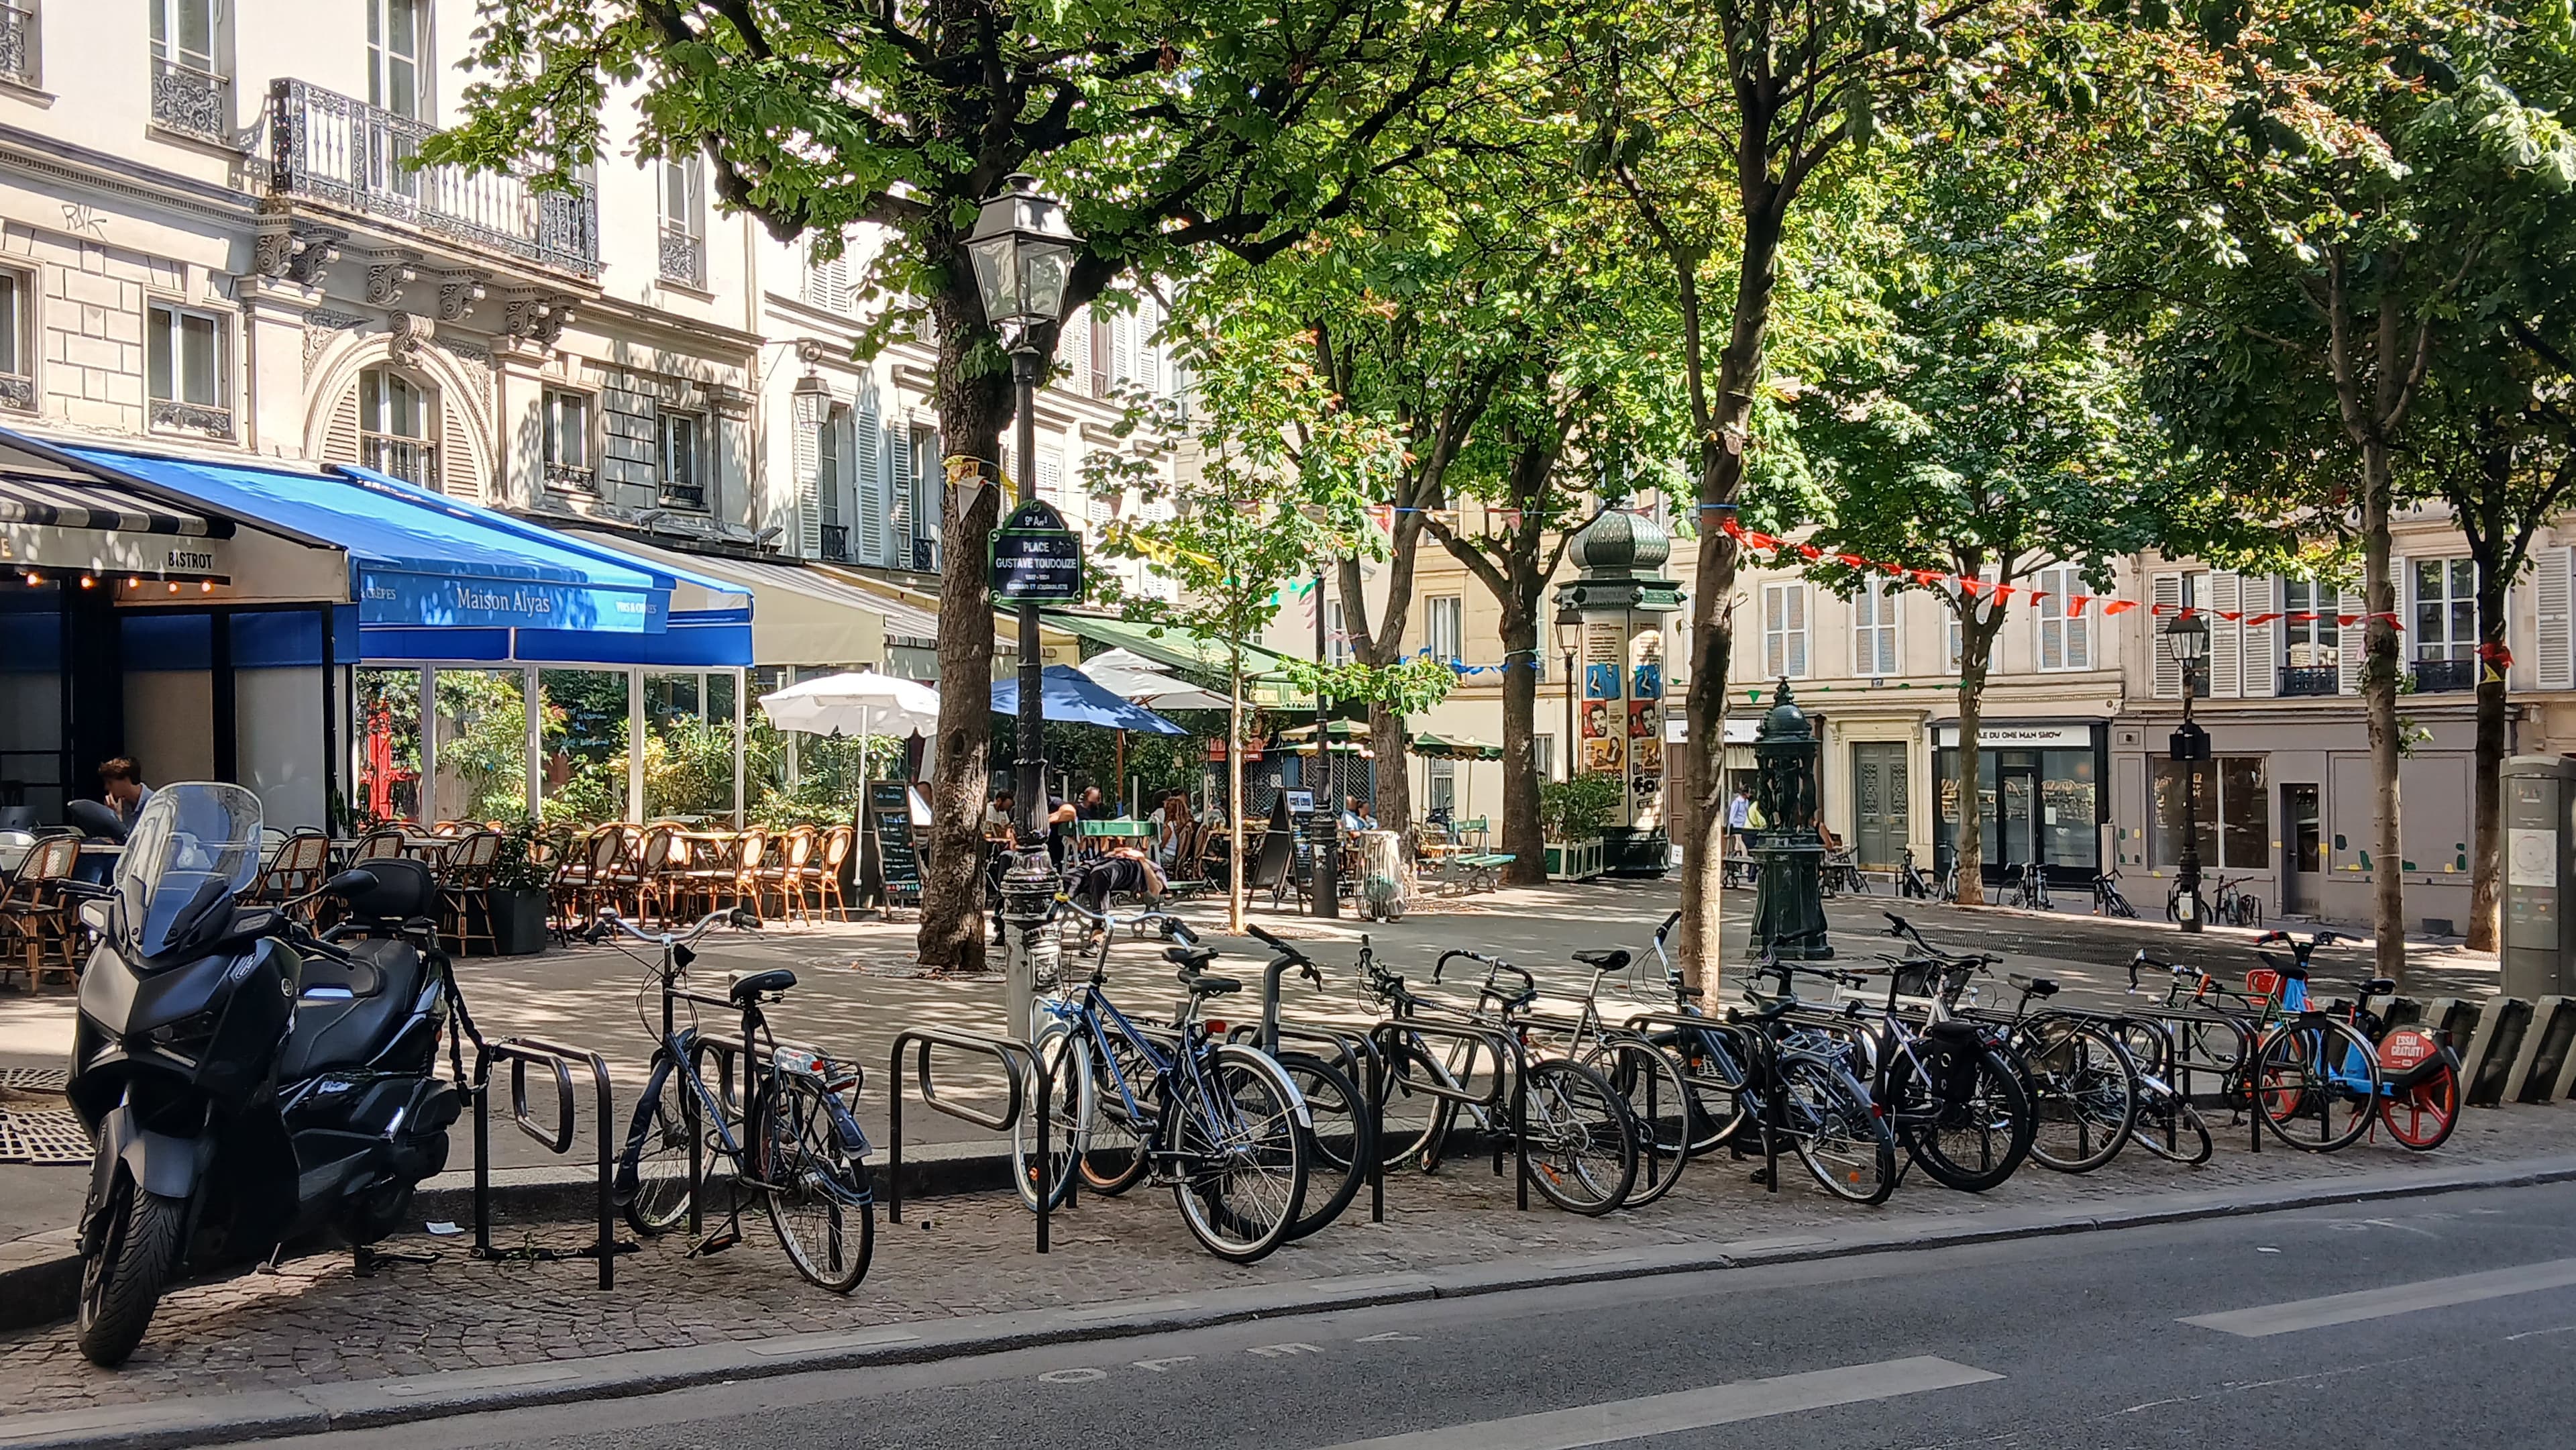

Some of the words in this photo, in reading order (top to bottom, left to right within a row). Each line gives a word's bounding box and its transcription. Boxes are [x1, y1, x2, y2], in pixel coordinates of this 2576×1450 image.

[1022, 541, 1050, 553] PLACE
[168, 551, 213, 570] BISTROT
[996, 558, 1034, 569] GUSTAVE
[1035, 558, 1077, 569] TOUDOUZE
[366, 585, 396, 601] CRÊPES
[457, 588, 510, 611] Maison
[513, 590, 551, 618] Alyas
[2038, 731, 2062, 739] SHOW
[2396, 1035, 2418, 1045] ESSAI
